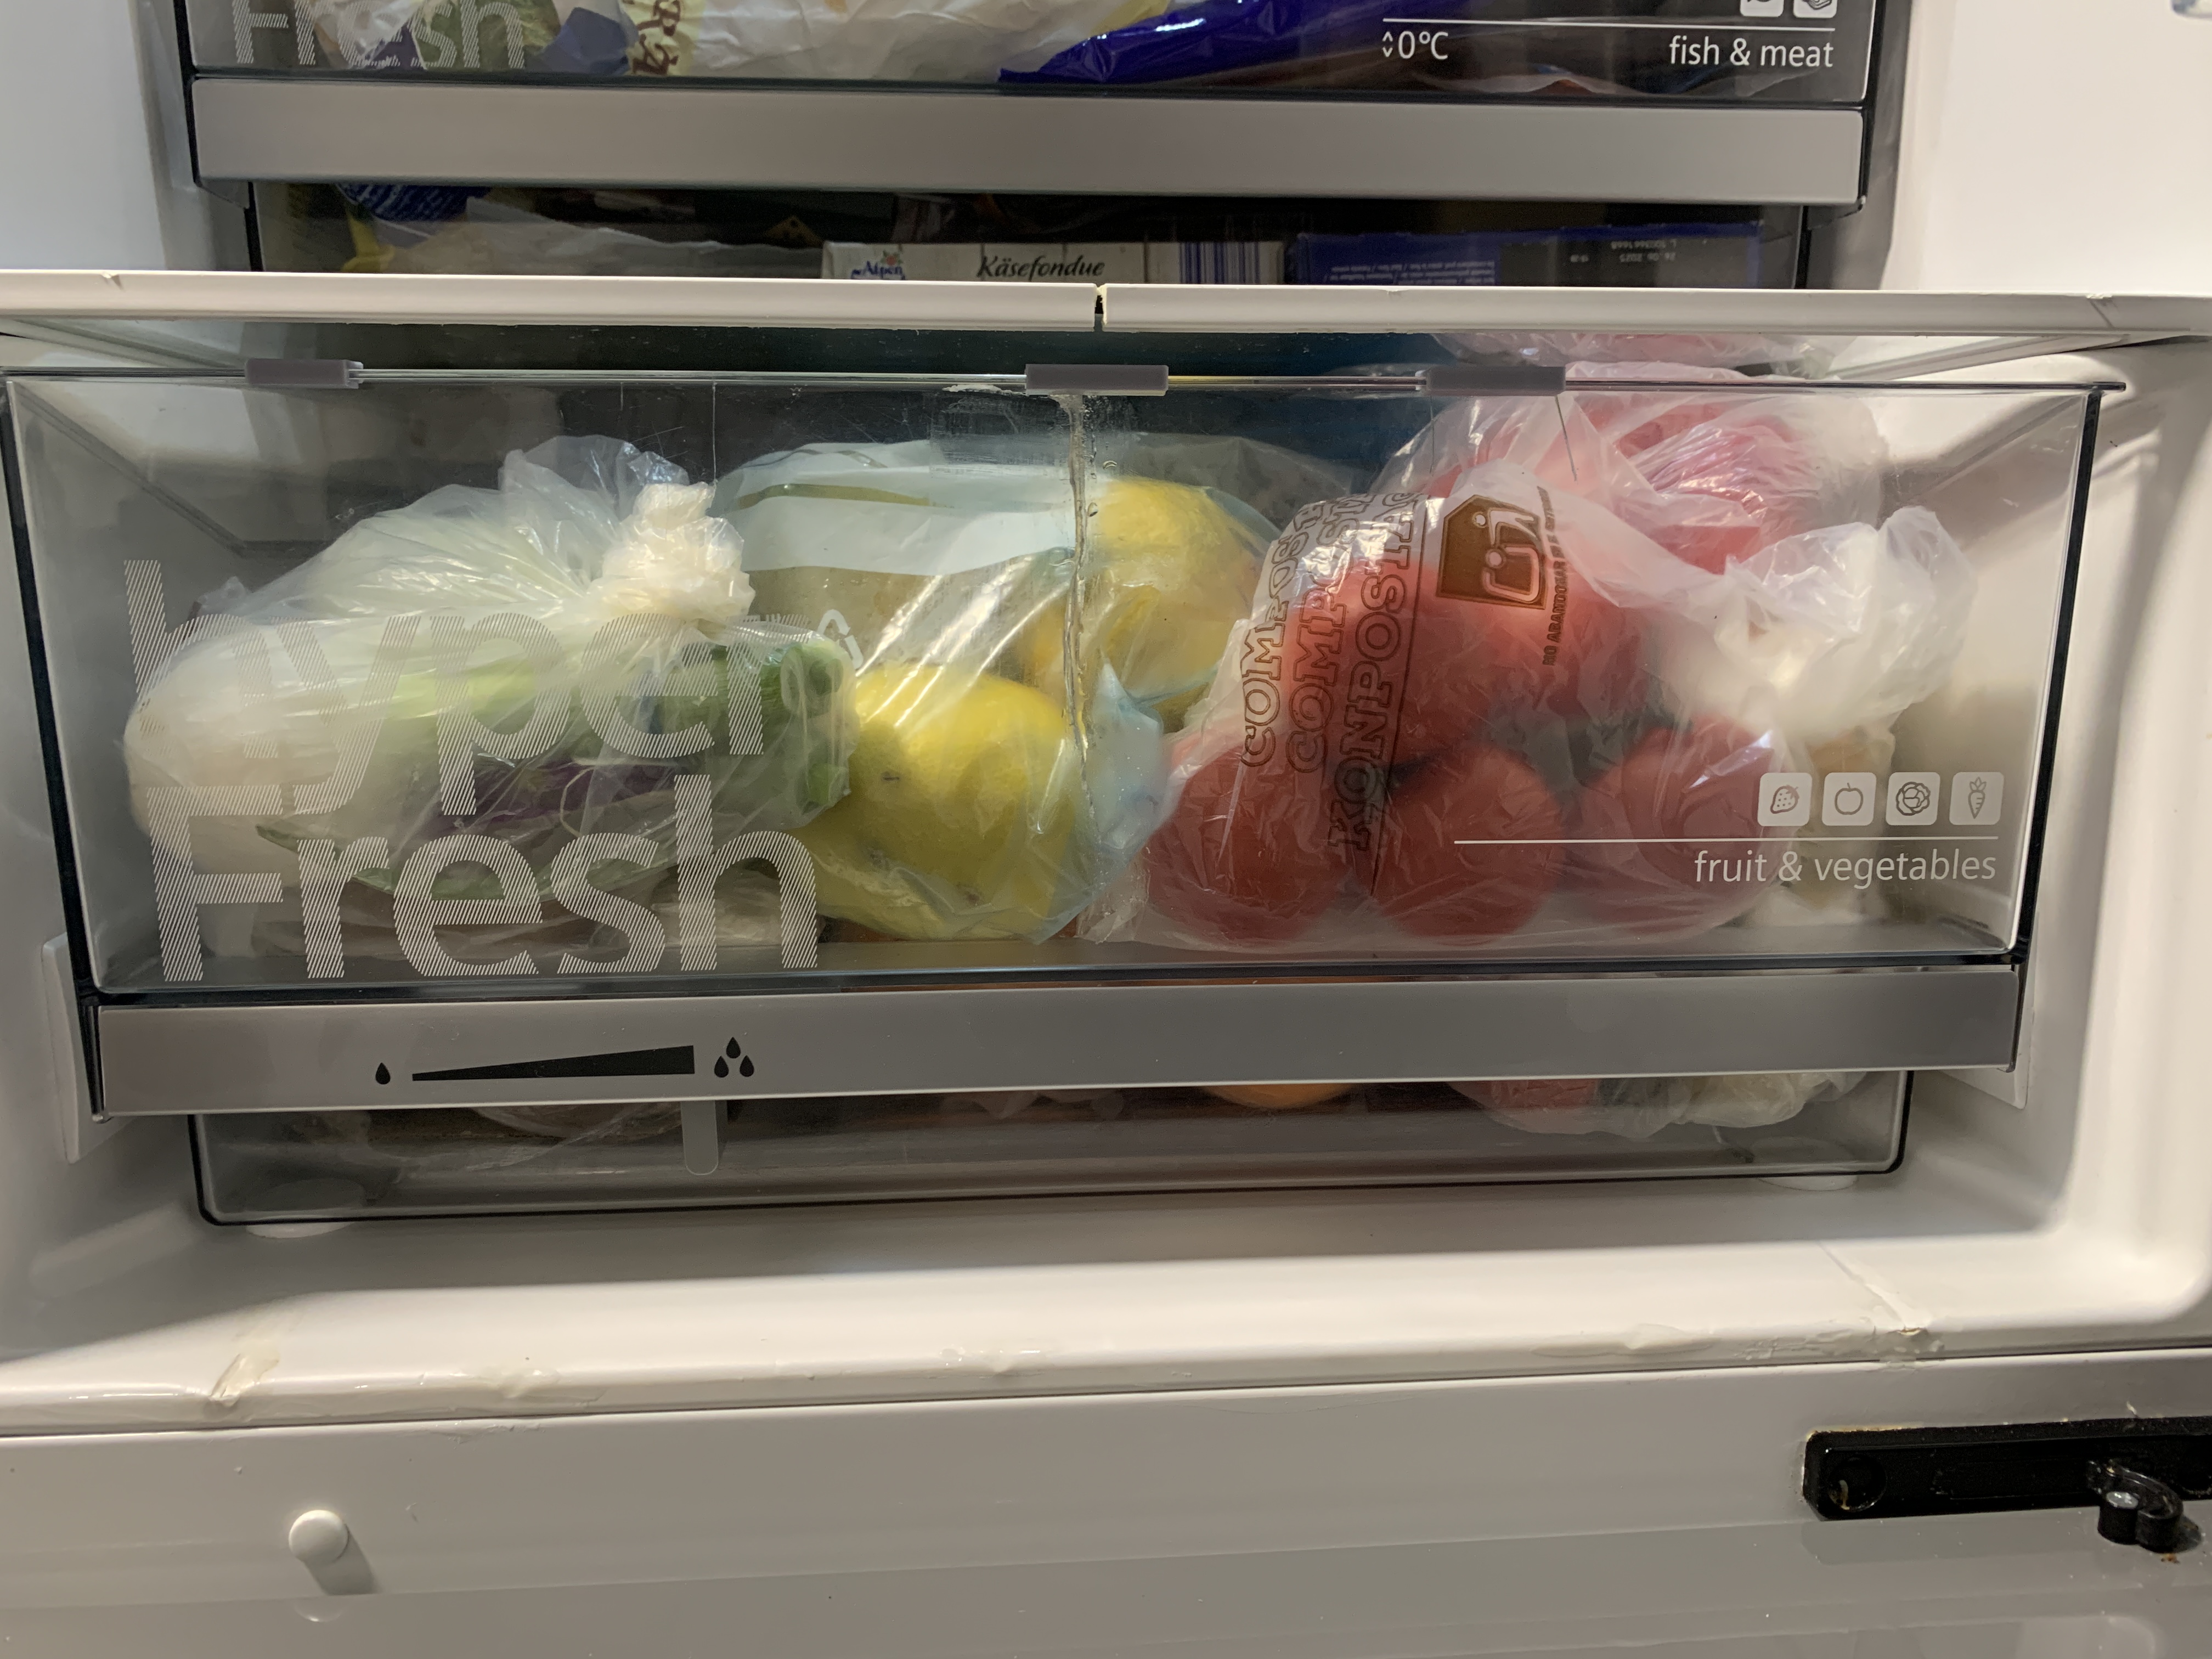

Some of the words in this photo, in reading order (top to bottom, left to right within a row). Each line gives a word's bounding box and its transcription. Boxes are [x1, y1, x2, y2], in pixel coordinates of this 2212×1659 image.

[1668, 35, 1720, 66] fish
[1729, 37, 1751, 66] &
[1760, 40, 1834, 69] meat
[977, 254, 1105, 281] Käsefondue
[124, 559, 812, 816] hyper
[146, 774, 819, 981] Fresh
[1694, 849, 1767, 883] fruit
[1778, 851, 1803, 882] &
[1814, 848, 1997, 890] vegetables
